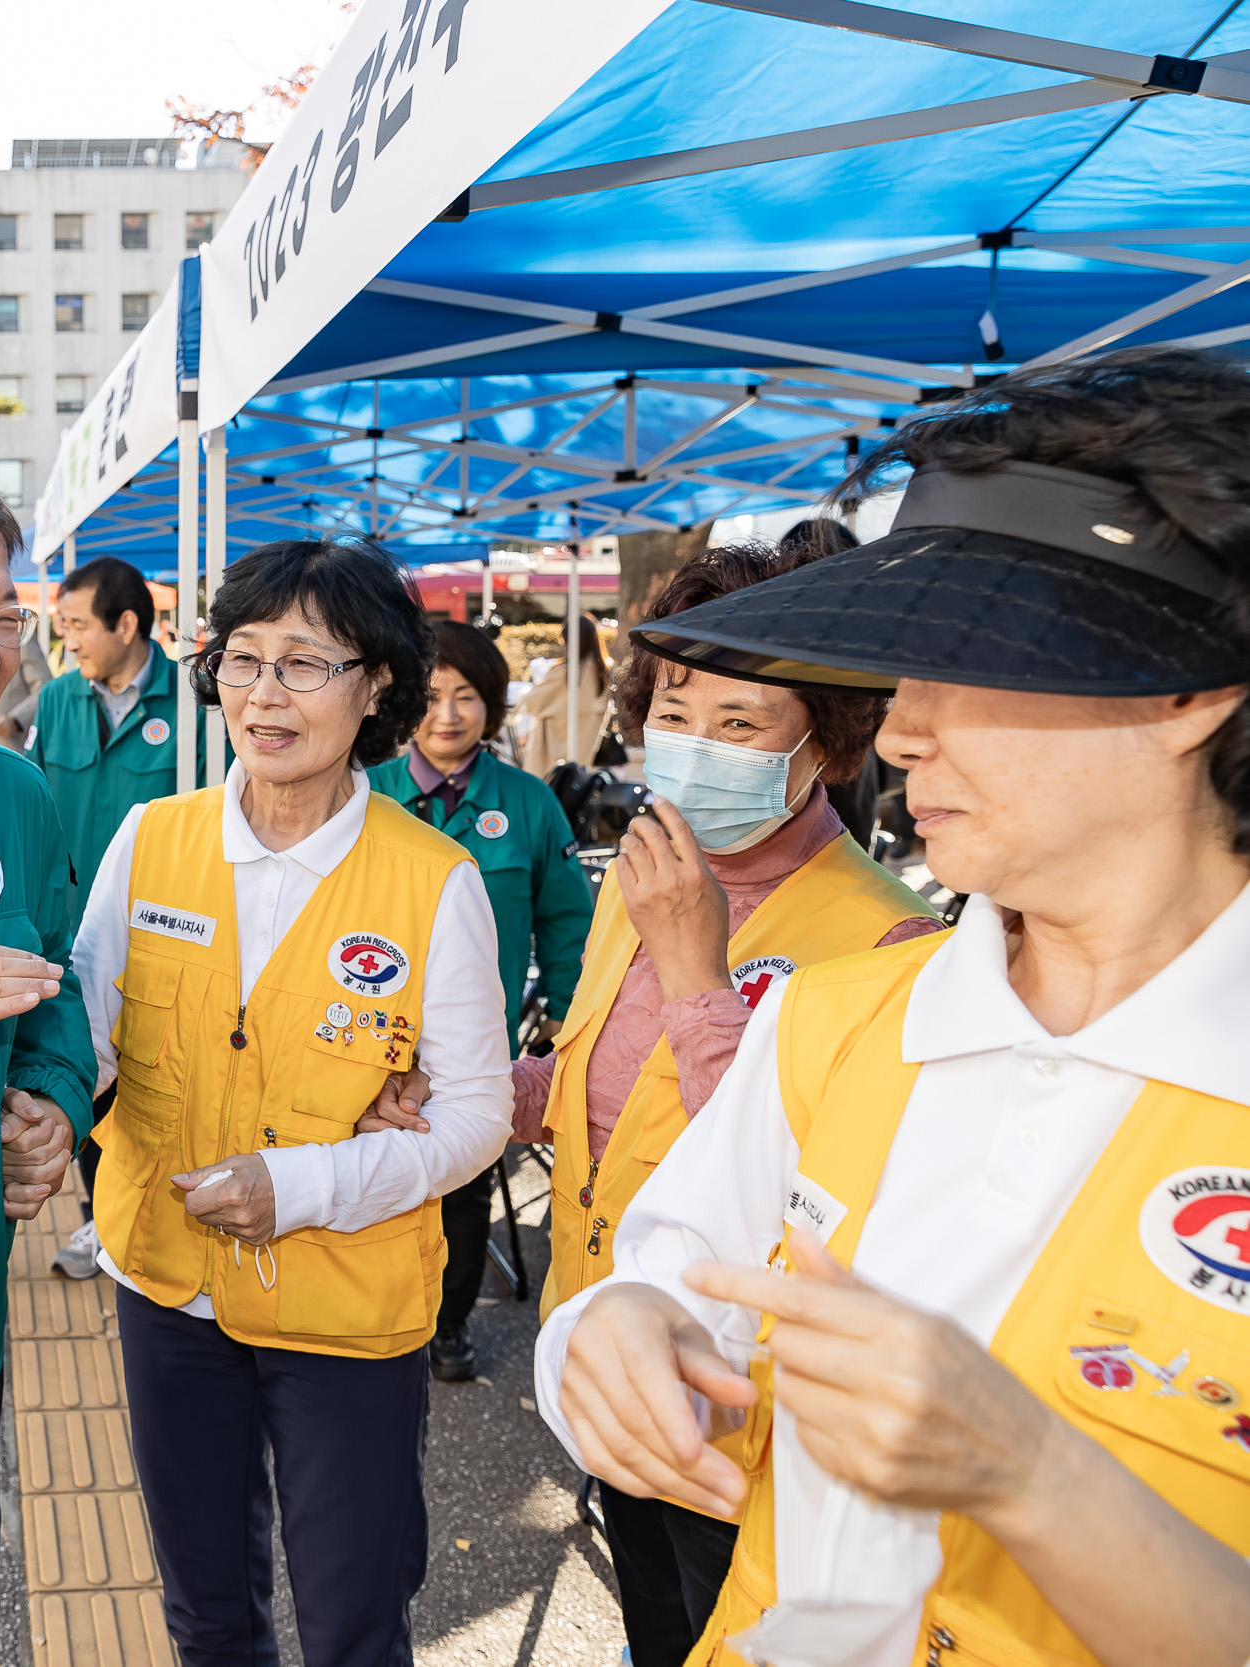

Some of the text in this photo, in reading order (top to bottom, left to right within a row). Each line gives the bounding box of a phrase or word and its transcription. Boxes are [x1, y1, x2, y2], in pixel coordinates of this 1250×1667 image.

[244, 128, 324, 323] 2023
[138, 909, 206, 937] 서울특별시지사
[340, 935, 407, 968] KOREAN RED CROSS
[733, 959, 770, 981] KOREAN
[769, 958, 786, 969] RED
